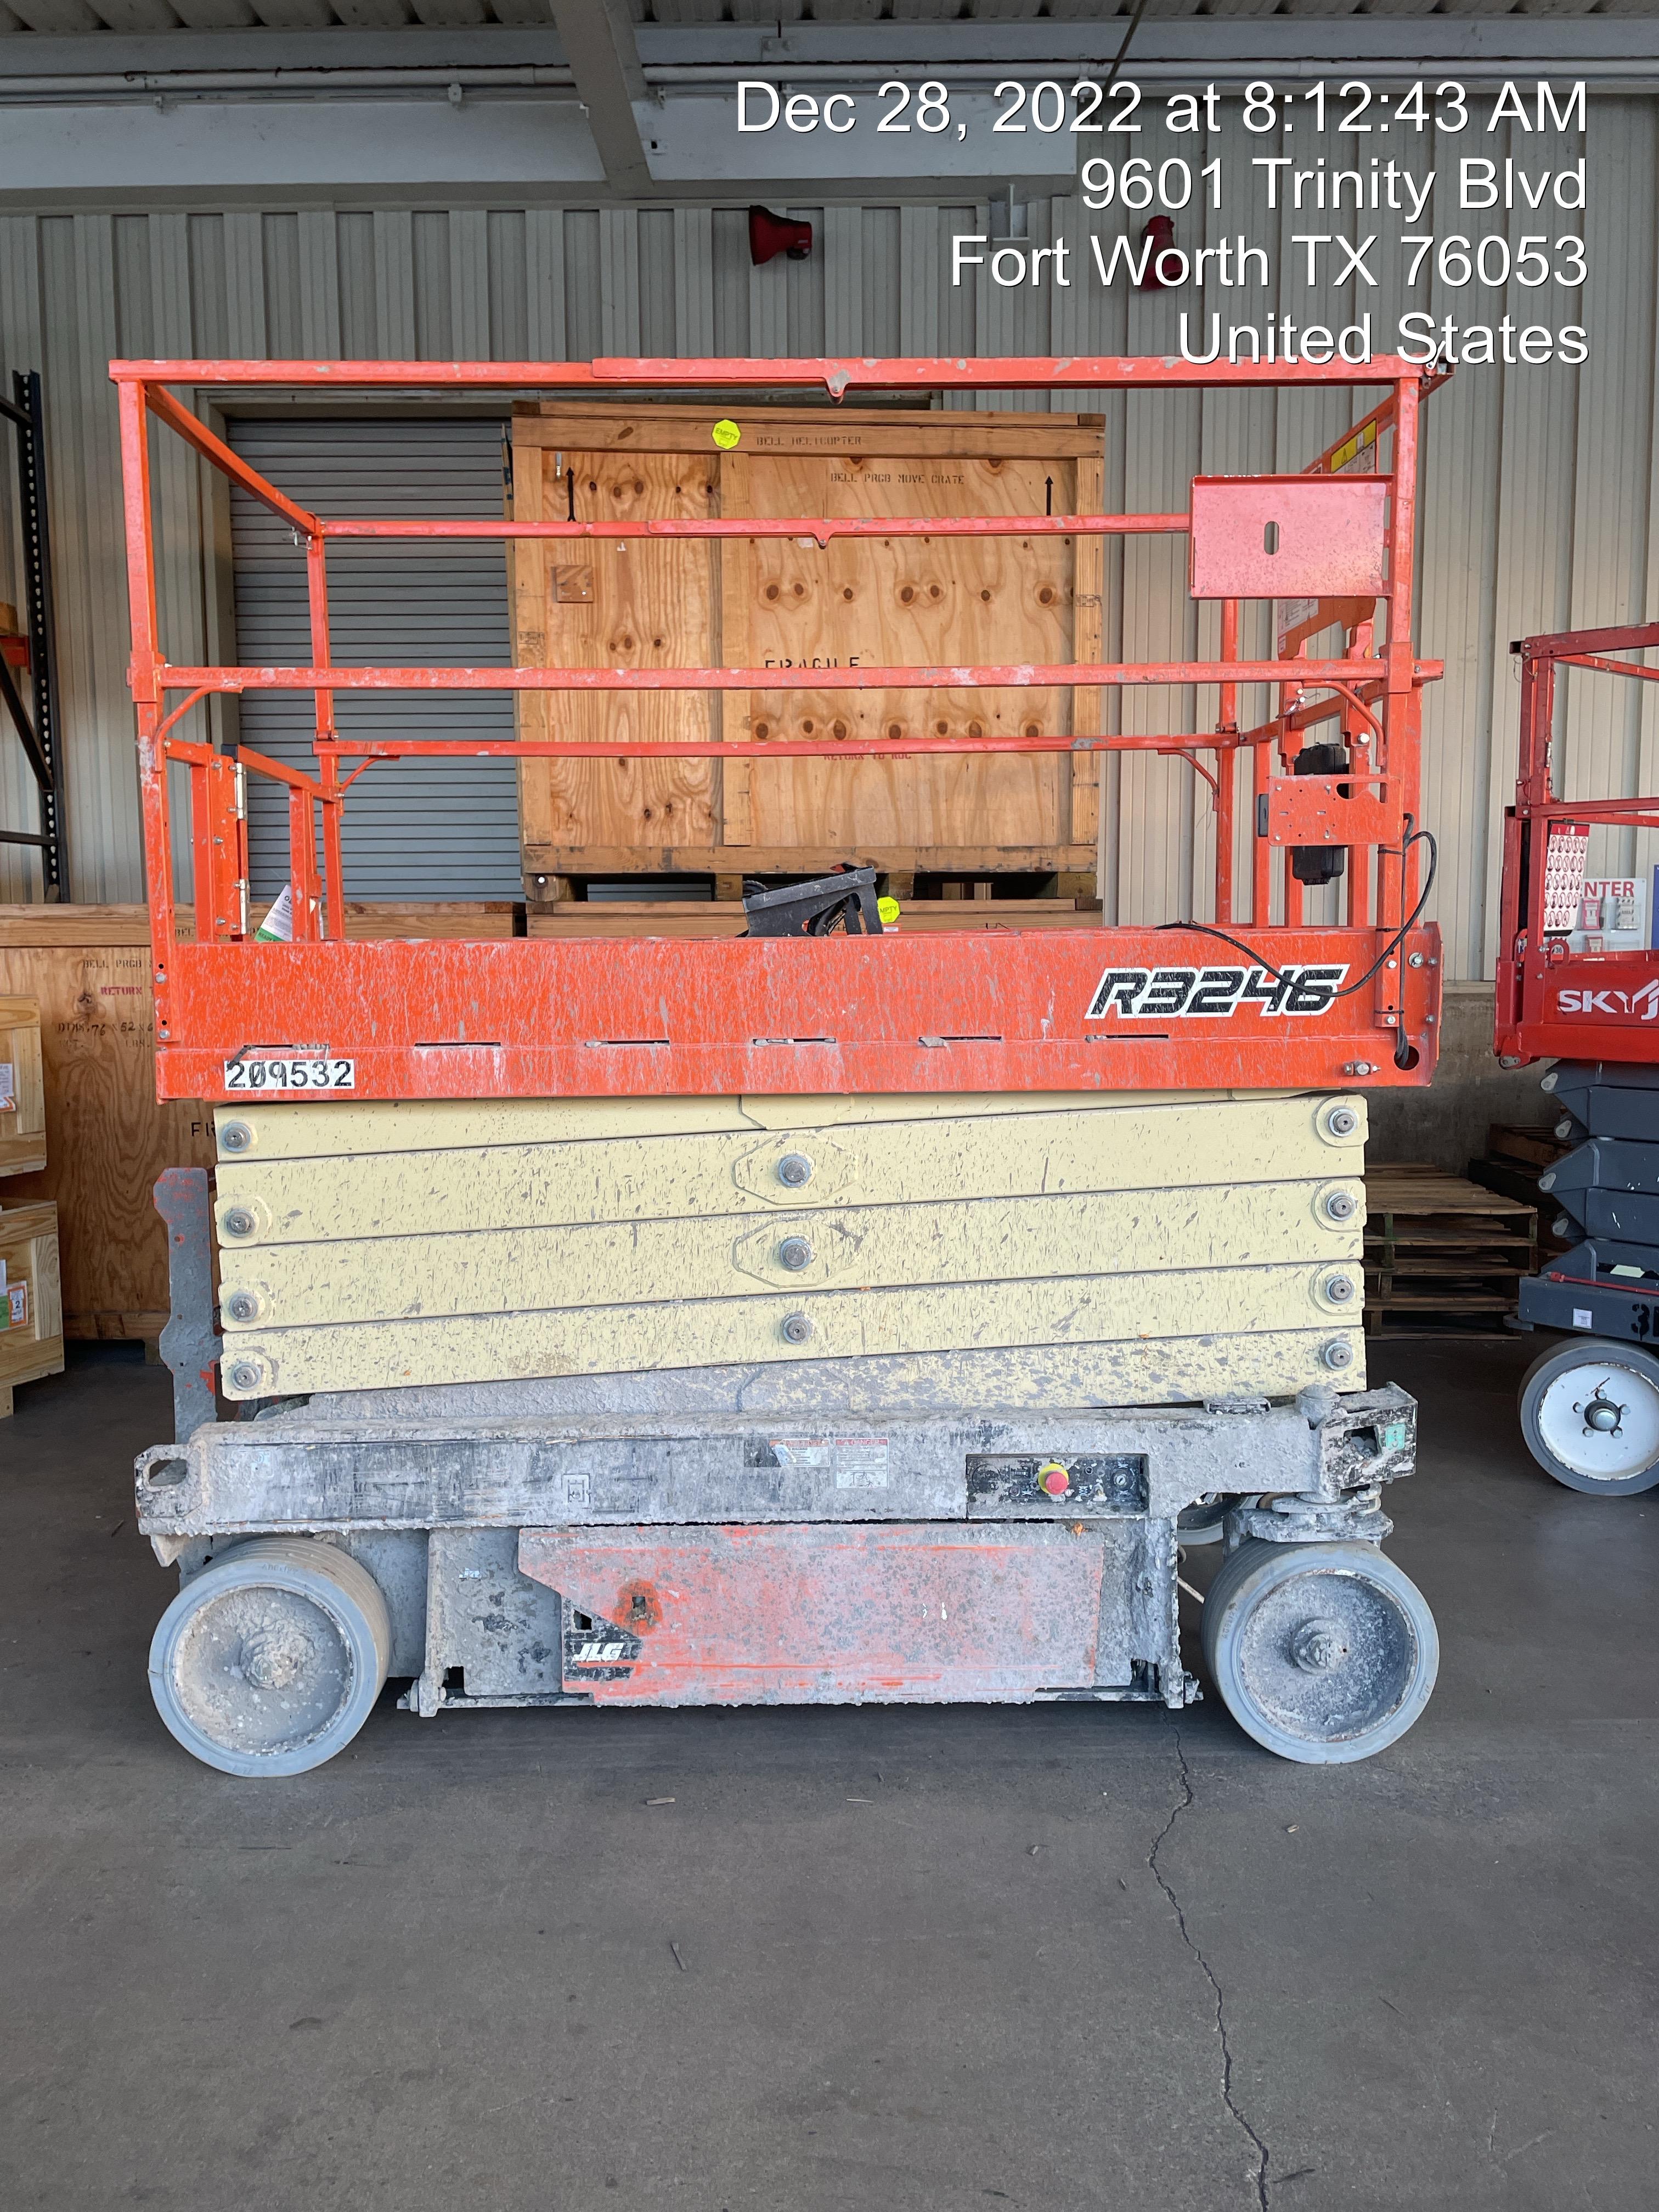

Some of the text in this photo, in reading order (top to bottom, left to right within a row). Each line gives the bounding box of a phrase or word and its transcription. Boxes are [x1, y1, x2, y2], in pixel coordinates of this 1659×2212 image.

[757, 436, 862, 446] BELL HELICOPTER
[831, 473, 857, 482] BELL
[898, 474, 924, 484] MOVE
[931, 475, 964, 484] CRATE
[1085, 964, 1350, 1019] R3246
[227, 1060, 352, 1088] 209532
[571, 1643, 624, 1661] JLG
